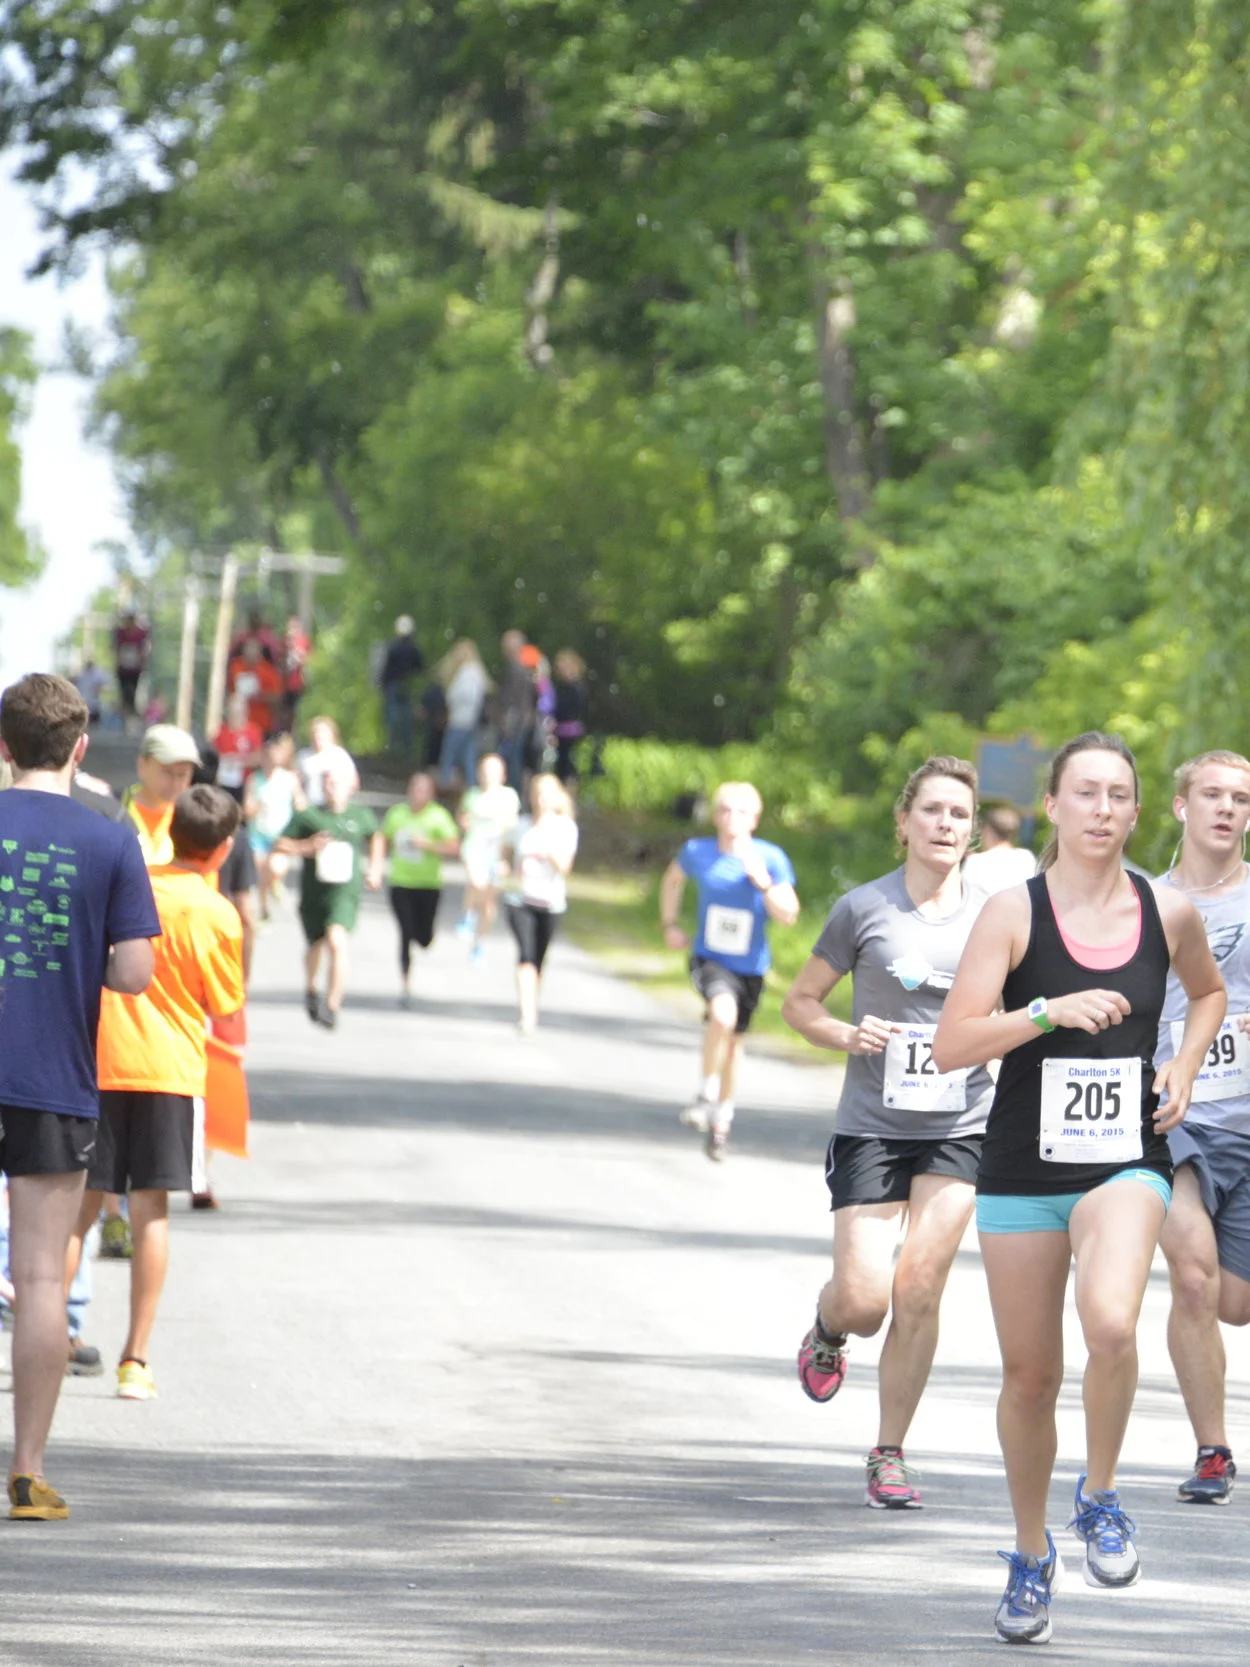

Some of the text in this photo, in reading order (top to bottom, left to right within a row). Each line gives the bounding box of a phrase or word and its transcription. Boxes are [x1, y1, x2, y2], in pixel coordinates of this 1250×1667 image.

[905, 1042, 934, 1074] 12
[1207, 1034, 1236, 1067] 39
[1068, 1067, 1120, 1076] Charlton 5K
[1064, 1081, 1121, 1121] 205
[1089, 1129, 1098, 1137] 6,
[1102, 1128, 1124, 1136] 2015
